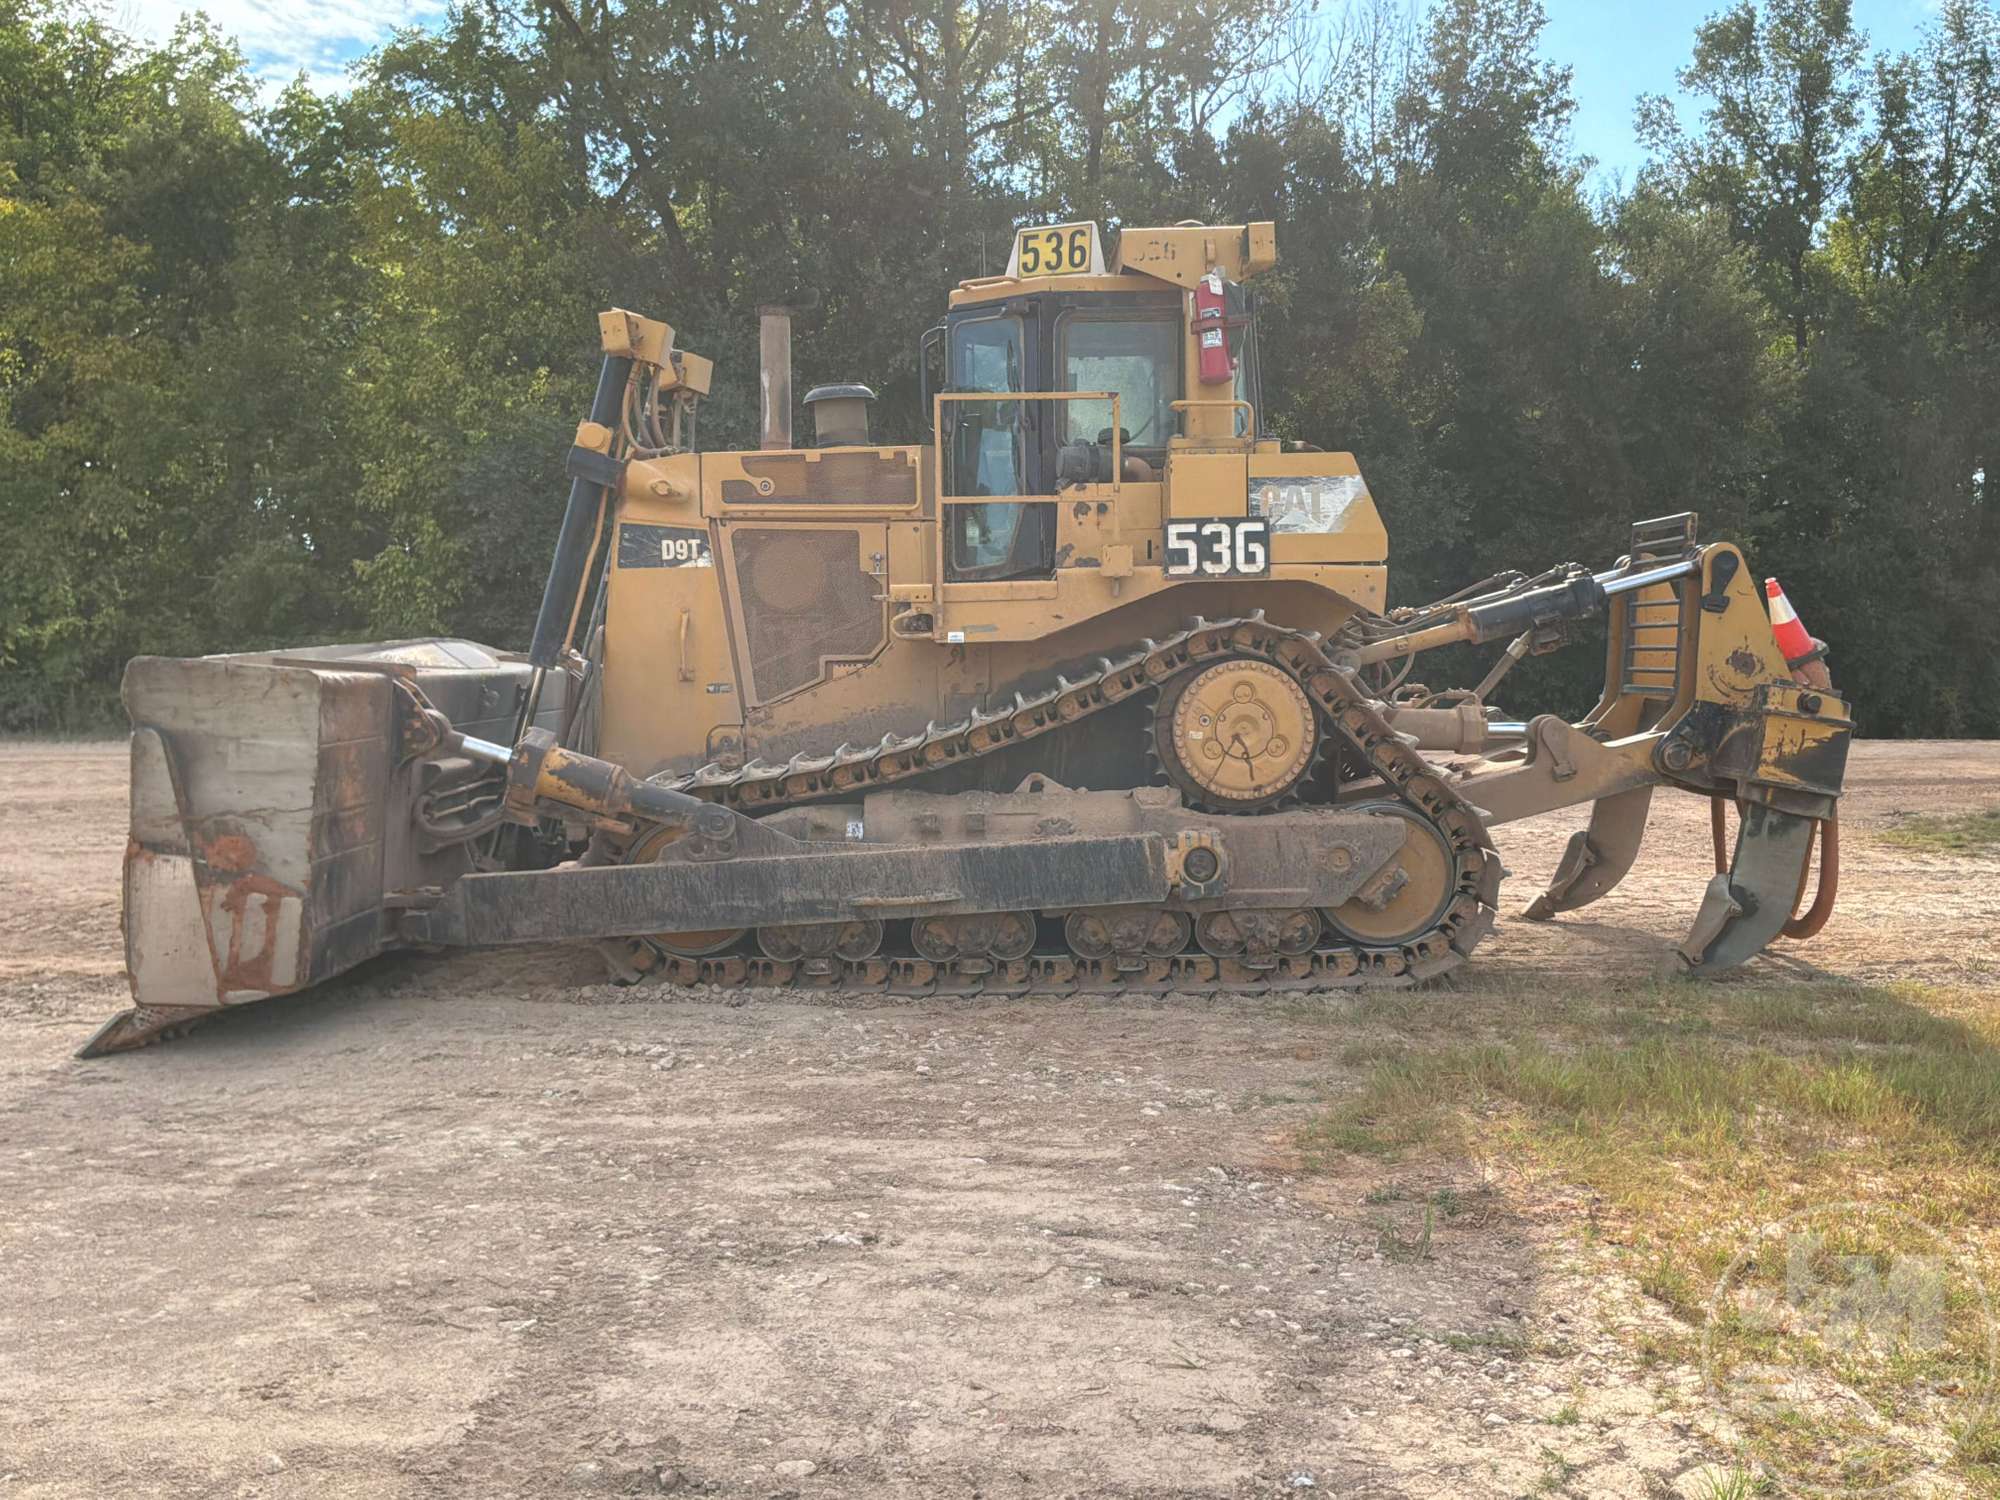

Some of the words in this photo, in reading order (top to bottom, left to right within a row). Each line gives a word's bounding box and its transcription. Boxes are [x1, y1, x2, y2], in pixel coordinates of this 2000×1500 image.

[1022, 229, 1087, 273] 536
[661, 539, 701, 561] D9T
[1167, 522, 1265, 575] 536
